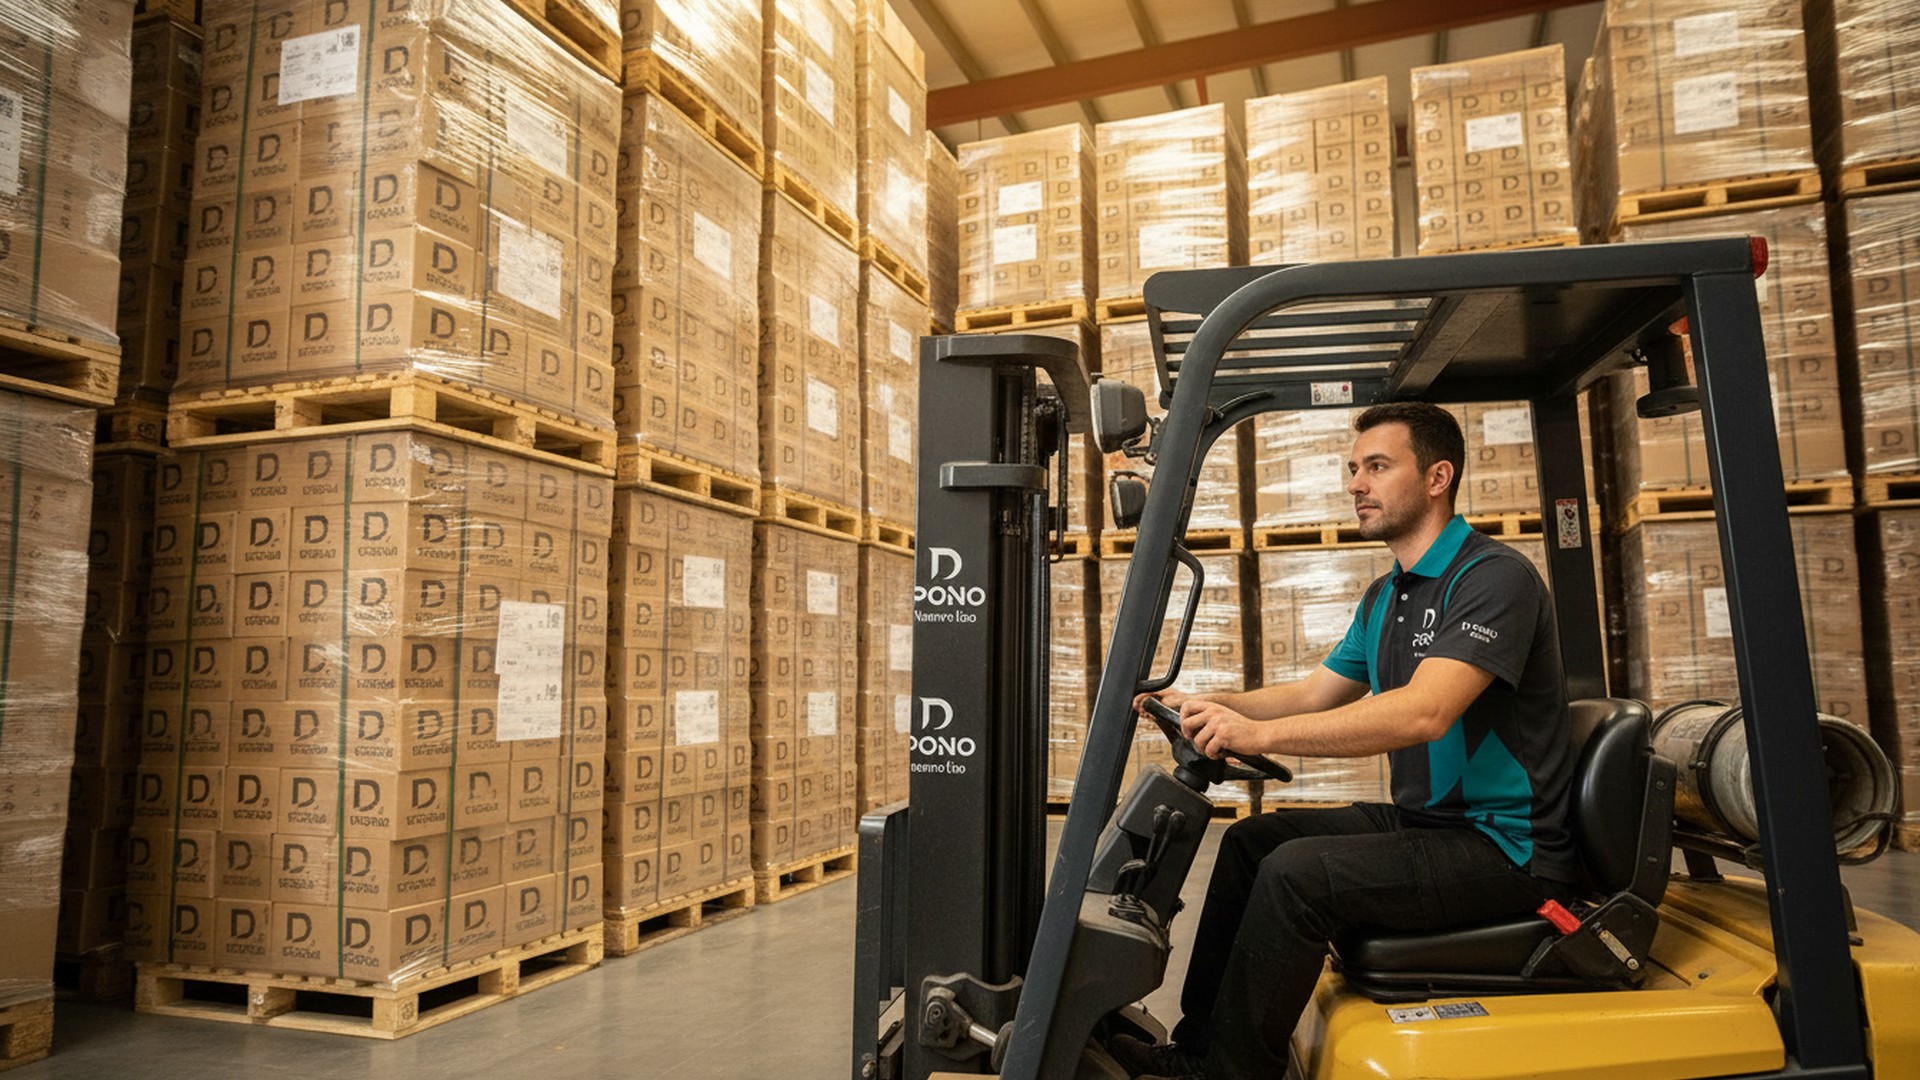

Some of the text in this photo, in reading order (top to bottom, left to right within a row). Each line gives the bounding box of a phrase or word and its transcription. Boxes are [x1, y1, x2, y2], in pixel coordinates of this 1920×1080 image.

[211, 86, 232, 113] D
[257, 134, 280, 162] D
[309, 186, 333, 215] D
[373, 175, 398, 204] D
[436, 177, 460, 211] D
[201, 206, 223, 234] D
[254, 196, 276, 224] D
[306, 249, 331, 277] D
[369, 239, 394, 267] D
[432, 242, 457, 274] D
[197, 266, 218, 294] D
[251, 256, 274, 285] D
[304, 312, 328, 341] D
[367, 303, 392, 332] D
[430, 308, 455, 338] D
[587, 312, 602, 336] D
[191, 328, 213, 356] D
[247, 319, 271, 348] D
[541, 350, 560, 376] D
[587, 366, 602, 391] D
[256, 453, 280, 481] D
[307, 451, 332, 479] D
[370, 444, 396, 472] D
[163, 464, 182, 491] D
[207, 459, 230, 486] D
[539, 474, 558, 499] D
[587, 485, 603, 509] D
[156, 525, 176, 551] D
[198, 522, 220, 550] D
[250, 517, 274, 546] D
[304, 516, 328, 544] D
[363, 512, 389, 540] D
[423, 514, 448, 542] D
[483, 522, 504, 549] D
[534, 532, 553, 559] D
[582, 540, 598, 564] D
[637, 552, 652, 573] D
[928, 547, 962, 579] D
[196, 584, 217, 612] D
[249, 582, 272, 610] D
[303, 580, 328, 608] D
[361, 578, 387, 606] D
[421, 580, 445, 608] D
[479, 584, 501, 611] D
[582, 596, 598, 620] D
[1423, 608, 1436, 628] D
[153, 649, 173, 676] D
[194, 647, 215, 674] D
[246, 646, 269, 674] D
[361, 644, 386, 673] D
[411, 644, 436, 673] D
[578, 650, 594, 675] D
[636, 654, 650, 677] D
[147, 710, 168, 738] D
[243, 709, 265, 738] D
[294, 710, 319, 741] D
[359, 711, 384, 740] D
[471, 708, 494, 735] D
[580, 706, 596, 730] D
[638, 705, 652, 727] D
[919, 697, 954, 730] D
[524, 767, 543, 794] D
[576, 762, 593, 787] D
[638, 756, 652, 779] D
[141, 774, 162, 803] D
[187, 774, 210, 803] D
[238, 775, 261, 804] D
[292, 777, 316, 807] D
[353, 779, 380, 812] D
[412, 778, 437, 809] D
[570, 817, 588, 842] D
[635, 807, 650, 830] D
[228, 840, 252, 871] D
[460, 836, 482, 864] D
[516, 828, 536, 856] D
[282, 844, 308, 873] D
[346, 847, 372, 877] D
[403, 844, 429, 876] D
[634, 859, 649, 883] D
[520, 887, 540, 916] D
[572, 875, 590, 902] D
[176, 905, 198, 934] D
[231, 909, 256, 939] D
[286, 913, 312, 943] D
[406, 913, 431, 945] D
[464, 900, 486, 931] D
[345, 918, 370, 948] D
